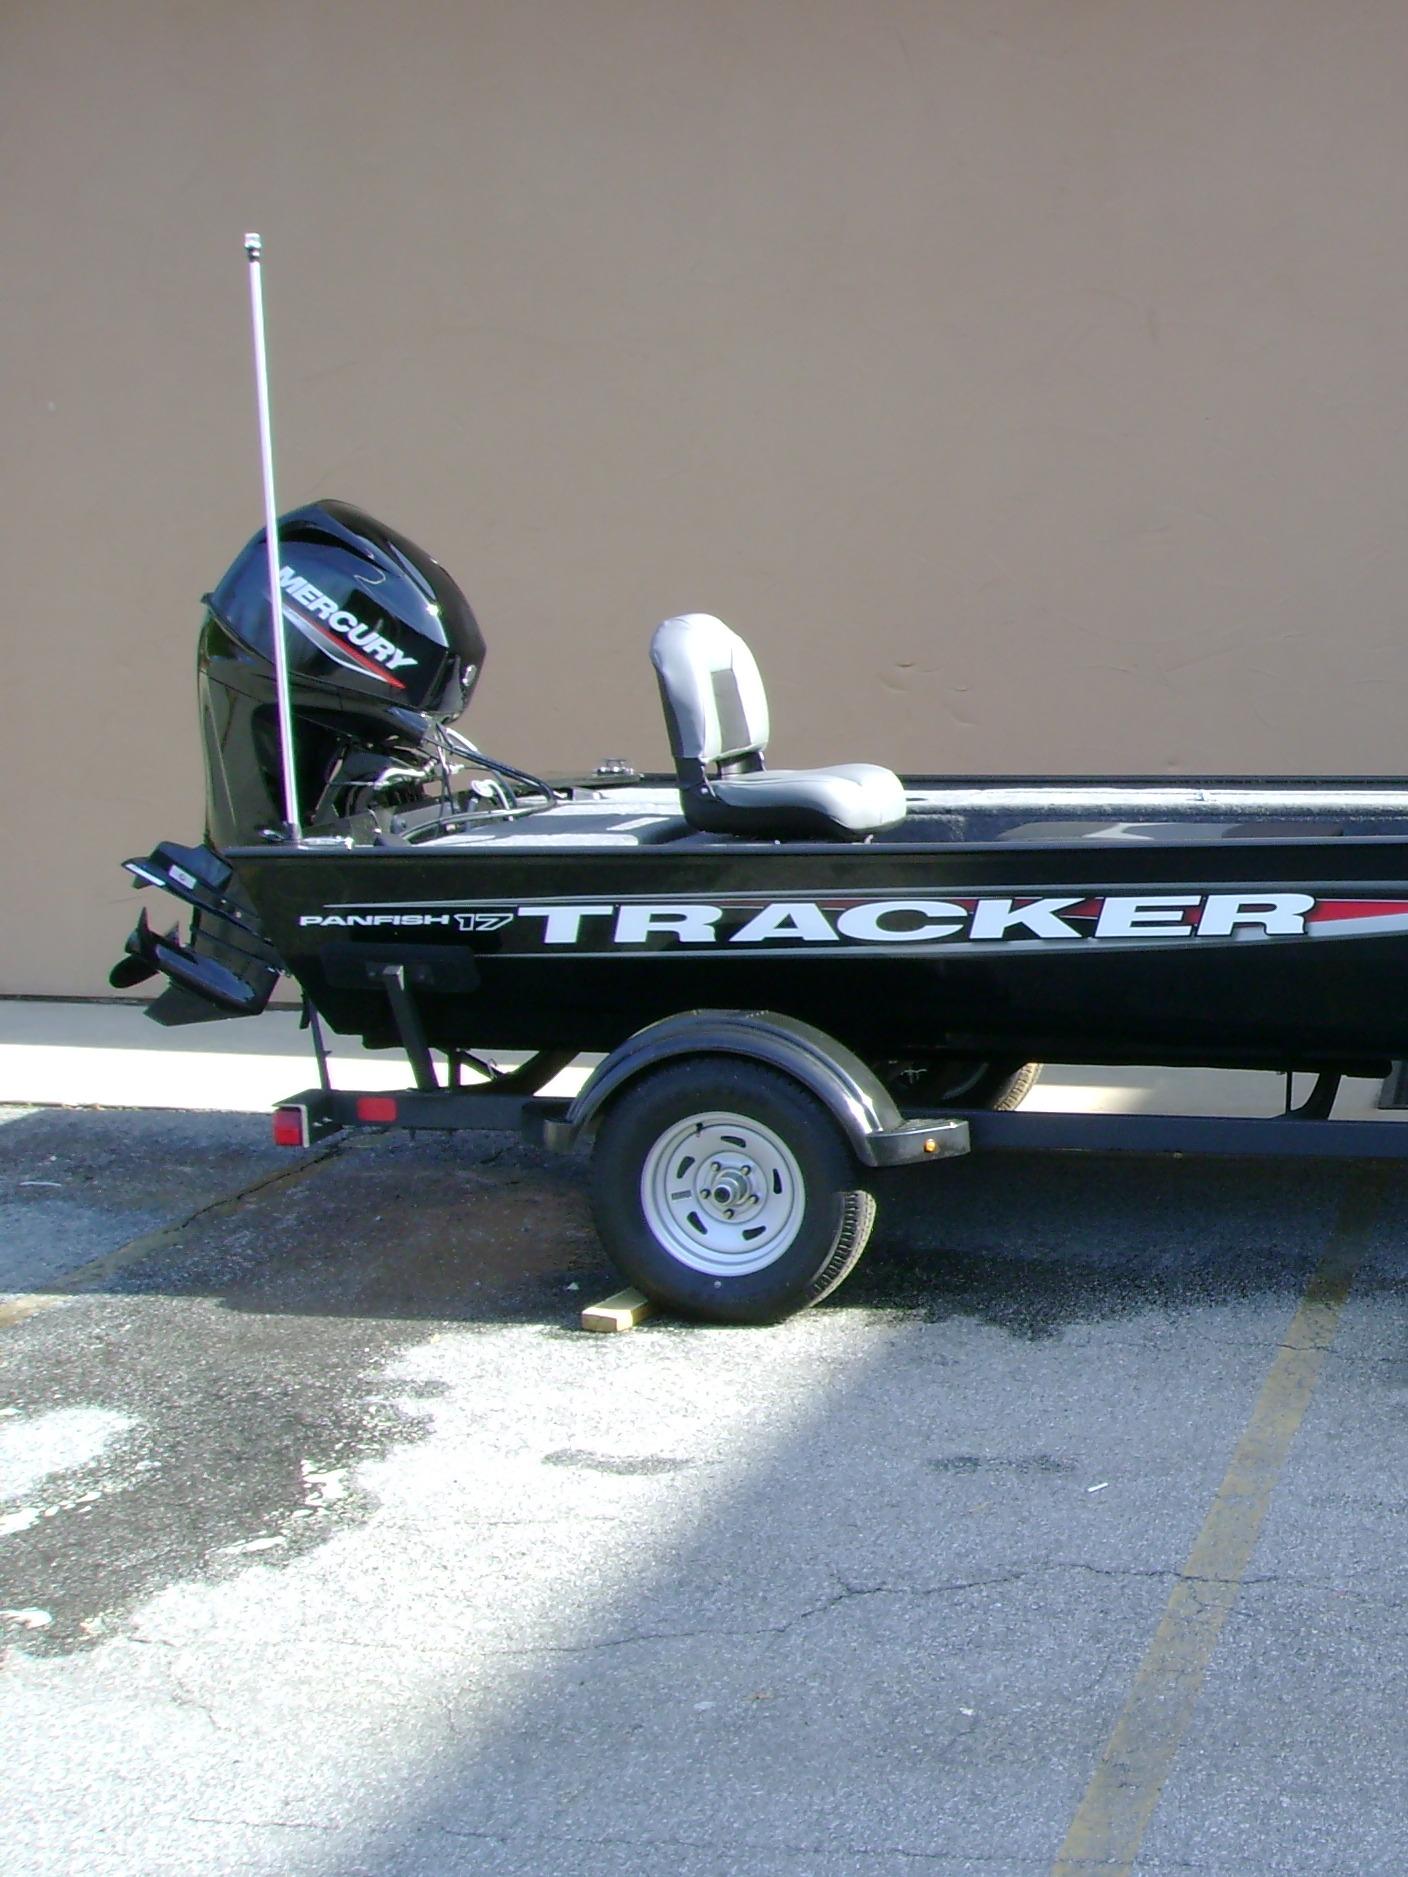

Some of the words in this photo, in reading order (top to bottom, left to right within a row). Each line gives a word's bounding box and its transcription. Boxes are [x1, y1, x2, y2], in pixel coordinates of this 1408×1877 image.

[279, 565, 418, 670] MERCURY
[299, 913, 450, 926] PANFISH
[453, 913, 514, 931] 17
[517, 893, 1317, 944] TRACKER
